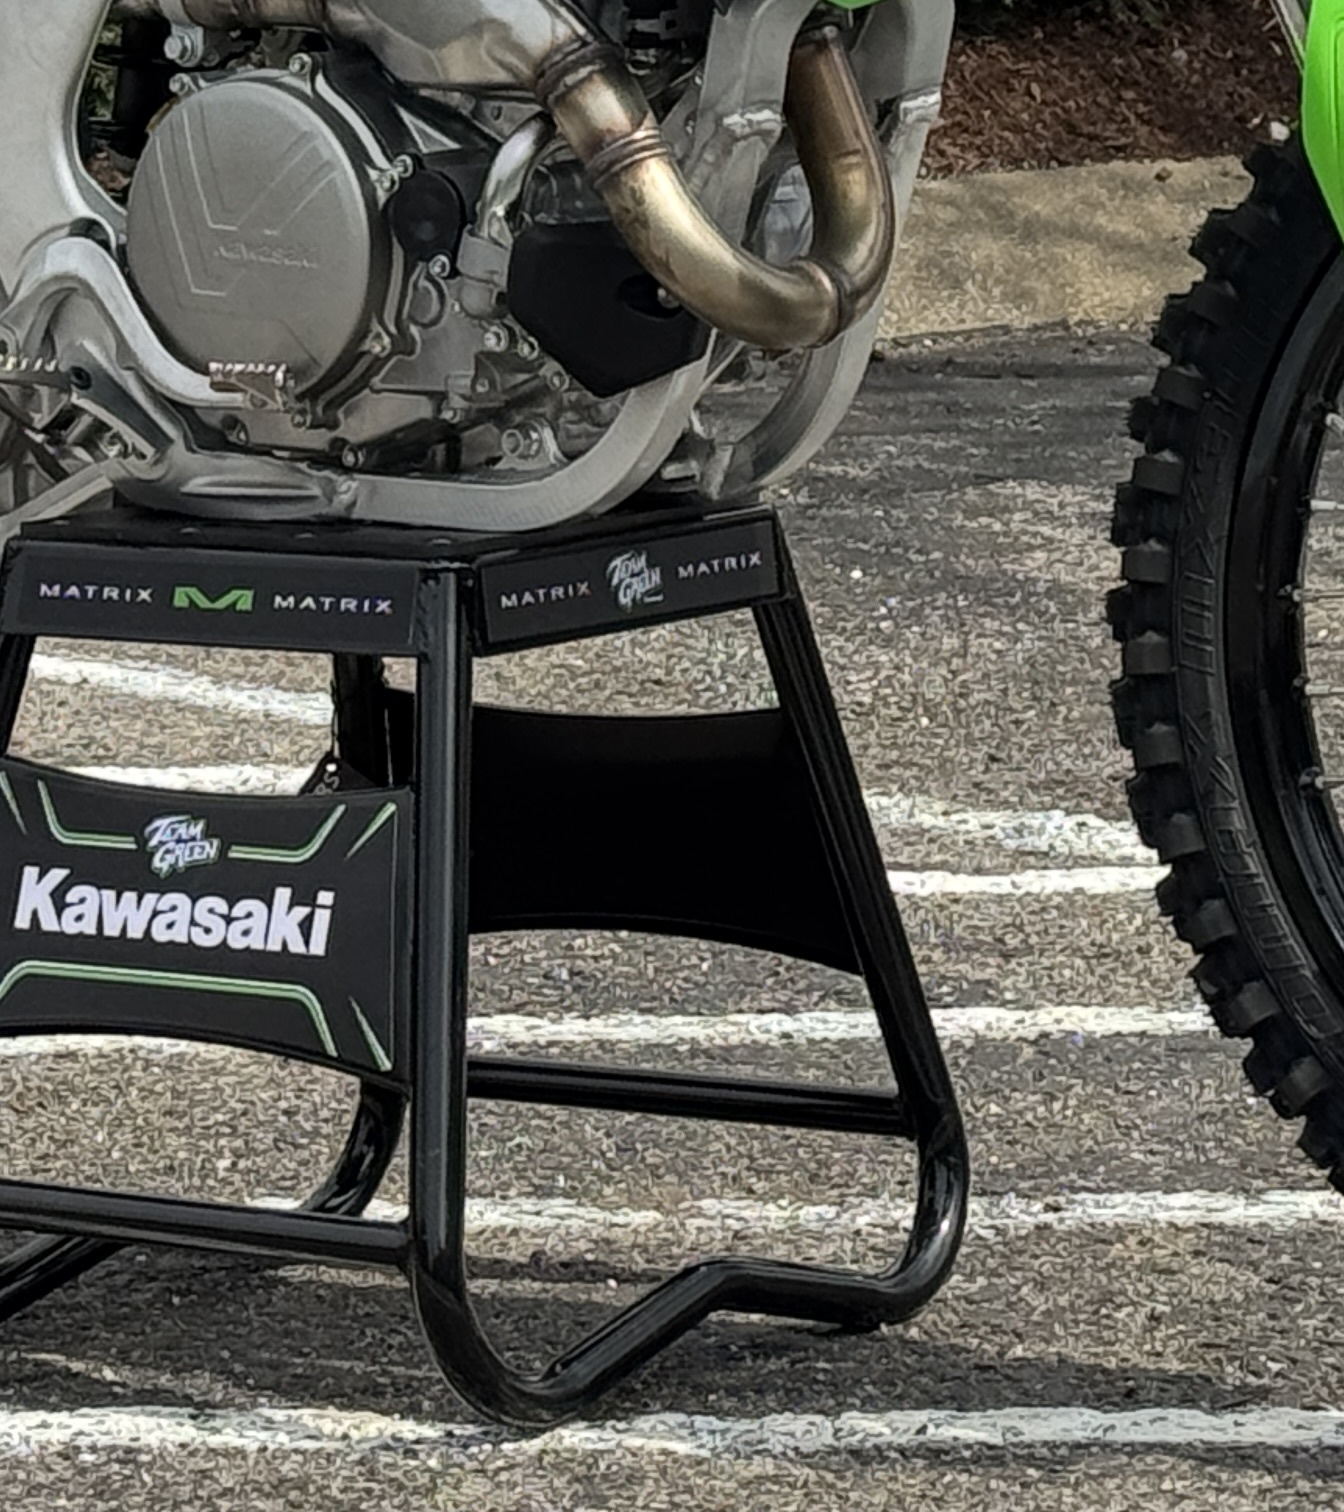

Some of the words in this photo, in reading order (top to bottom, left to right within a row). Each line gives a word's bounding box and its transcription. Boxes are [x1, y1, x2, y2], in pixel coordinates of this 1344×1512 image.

[677, 551, 763, 579] MATRIX
[40, 584, 154, 603] MATRIX
[273, 594, 393, 615] MATRIX
[500, 581, 591, 609] MATRIX
[145, 816, 206, 847] TEAM
[152, 839, 220, 875] GREEN
[14, 864, 336, 957] Kawasaki
